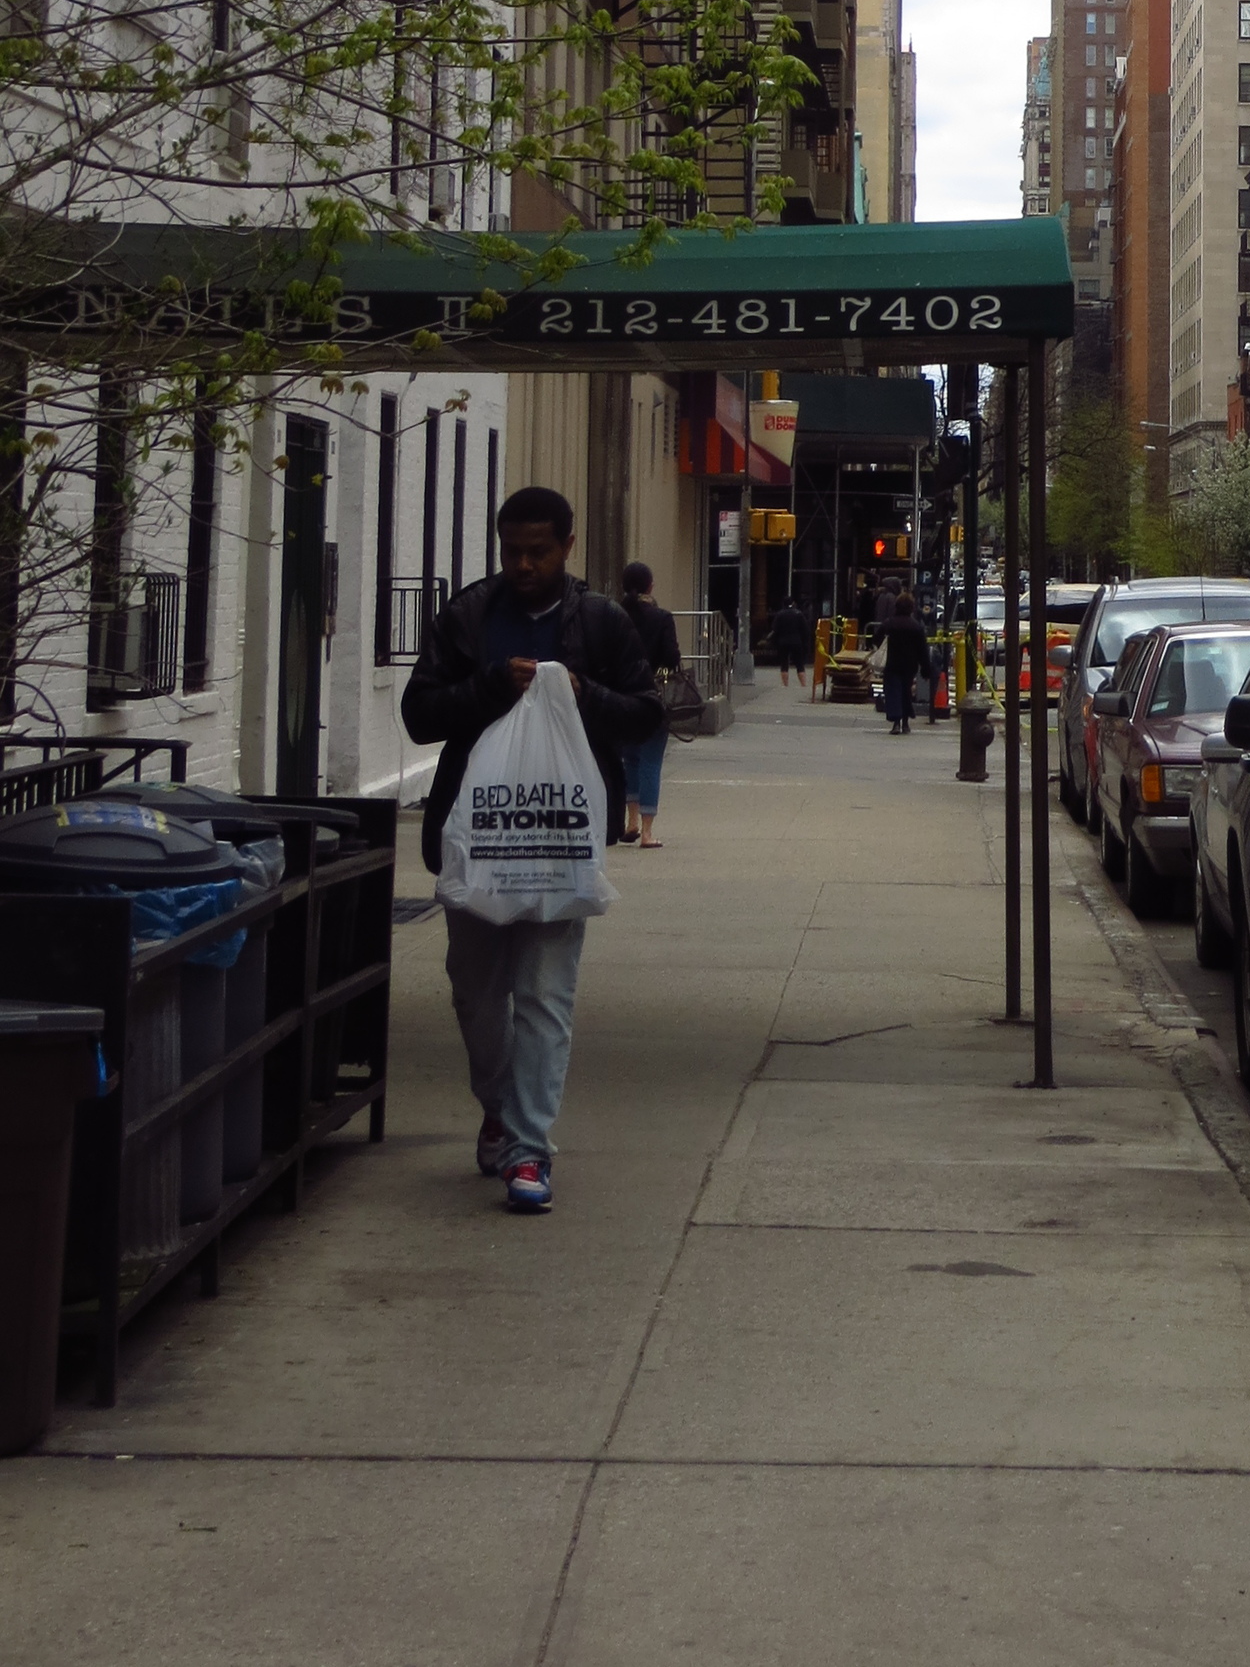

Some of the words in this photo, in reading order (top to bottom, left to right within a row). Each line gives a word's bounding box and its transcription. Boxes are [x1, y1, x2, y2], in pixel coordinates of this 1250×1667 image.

[539, 295, 1003, 334] 212-481-7402
[473, 785, 512, 809] BED
[515, 782, 566, 808] BATH
[571, 784, 589, 808] &
[472, 810, 590, 830] BEYOND
